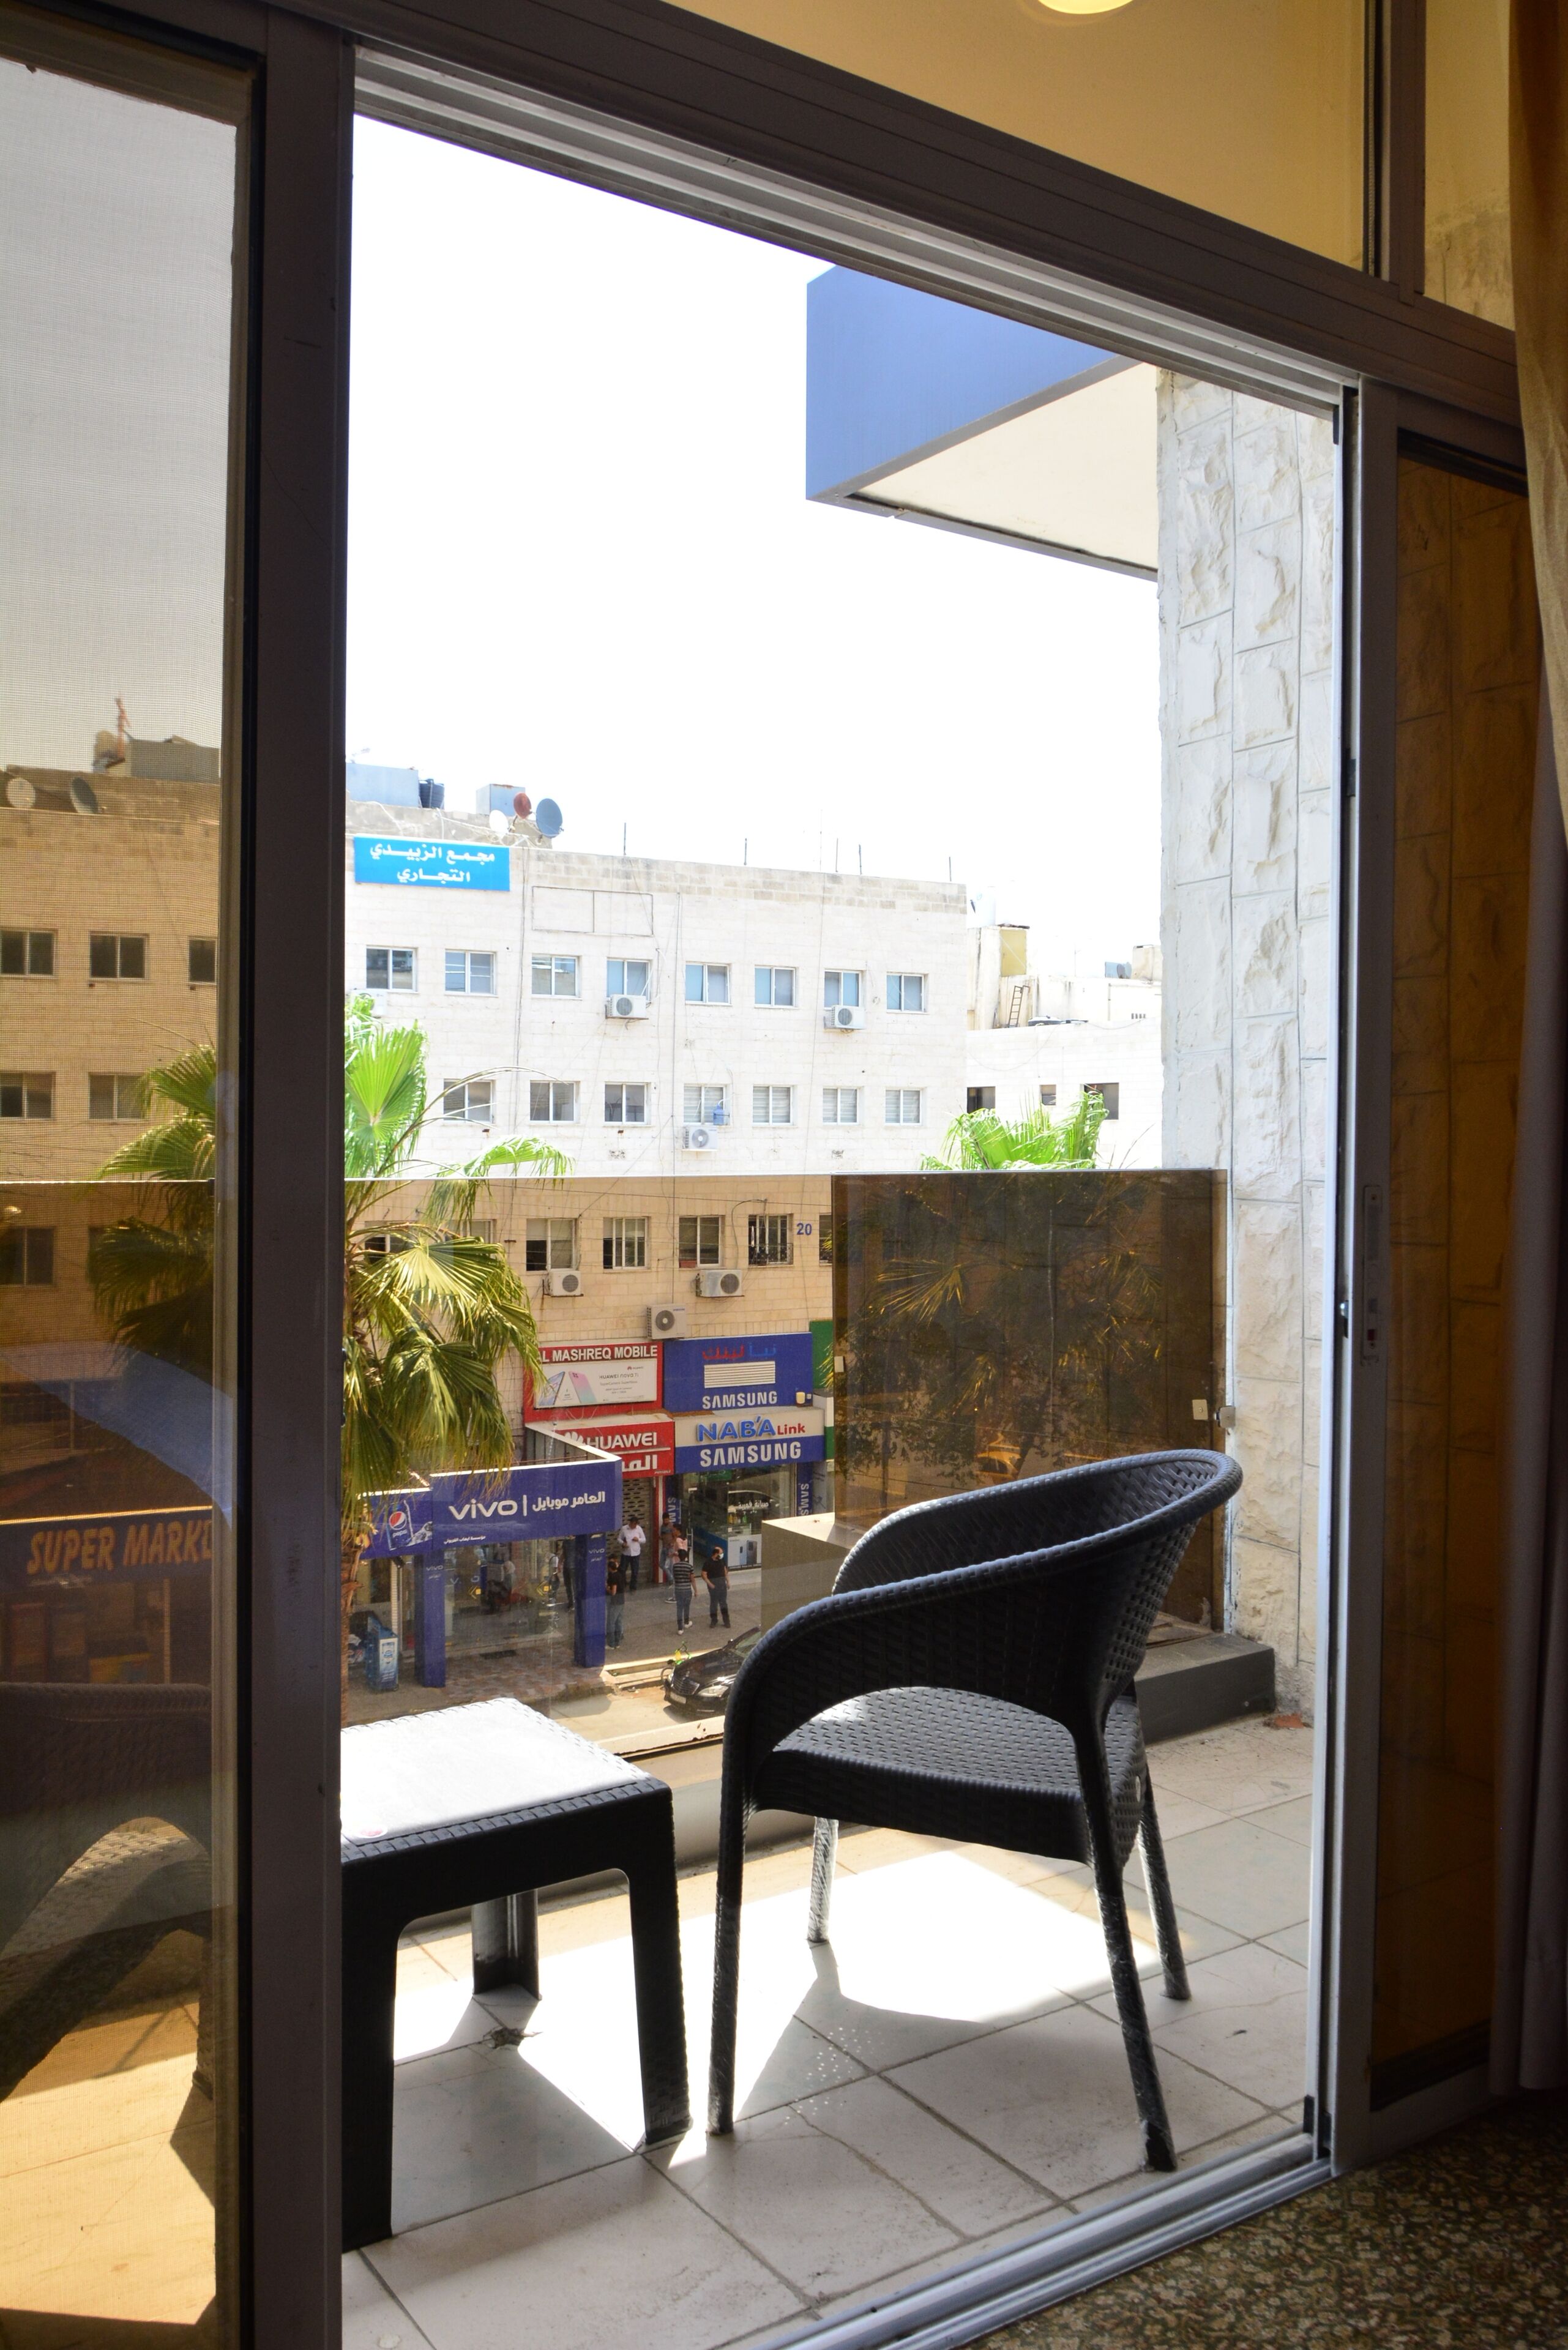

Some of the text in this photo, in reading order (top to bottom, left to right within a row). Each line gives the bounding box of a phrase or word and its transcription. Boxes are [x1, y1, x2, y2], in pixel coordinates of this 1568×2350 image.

[370, 843, 495, 865] مجمع الزبيدي
[397, 868, 471, 884] التجاري
[797, 1223, 812, 1236] 20
[553, 1347, 611, 1361] MASHREQ
[614, 1345, 658, 1359] MOBILE
[702, 1390, 777, 1409] SAMSUNG
[777, 1423, 805, 1435] Link
[587, 1431, 657, 1450] HUAWEI
[700, 1441, 801, 1468] SAMSUNG
[532, 1491, 605, 1512] العامر موبايل
[801, 1483, 809, 1515] SAMS
[449, 1498, 518, 1520] vivo
[392, 1529, 408, 1538] pepsi
[27, 1526, 116, 1575] SUPER
